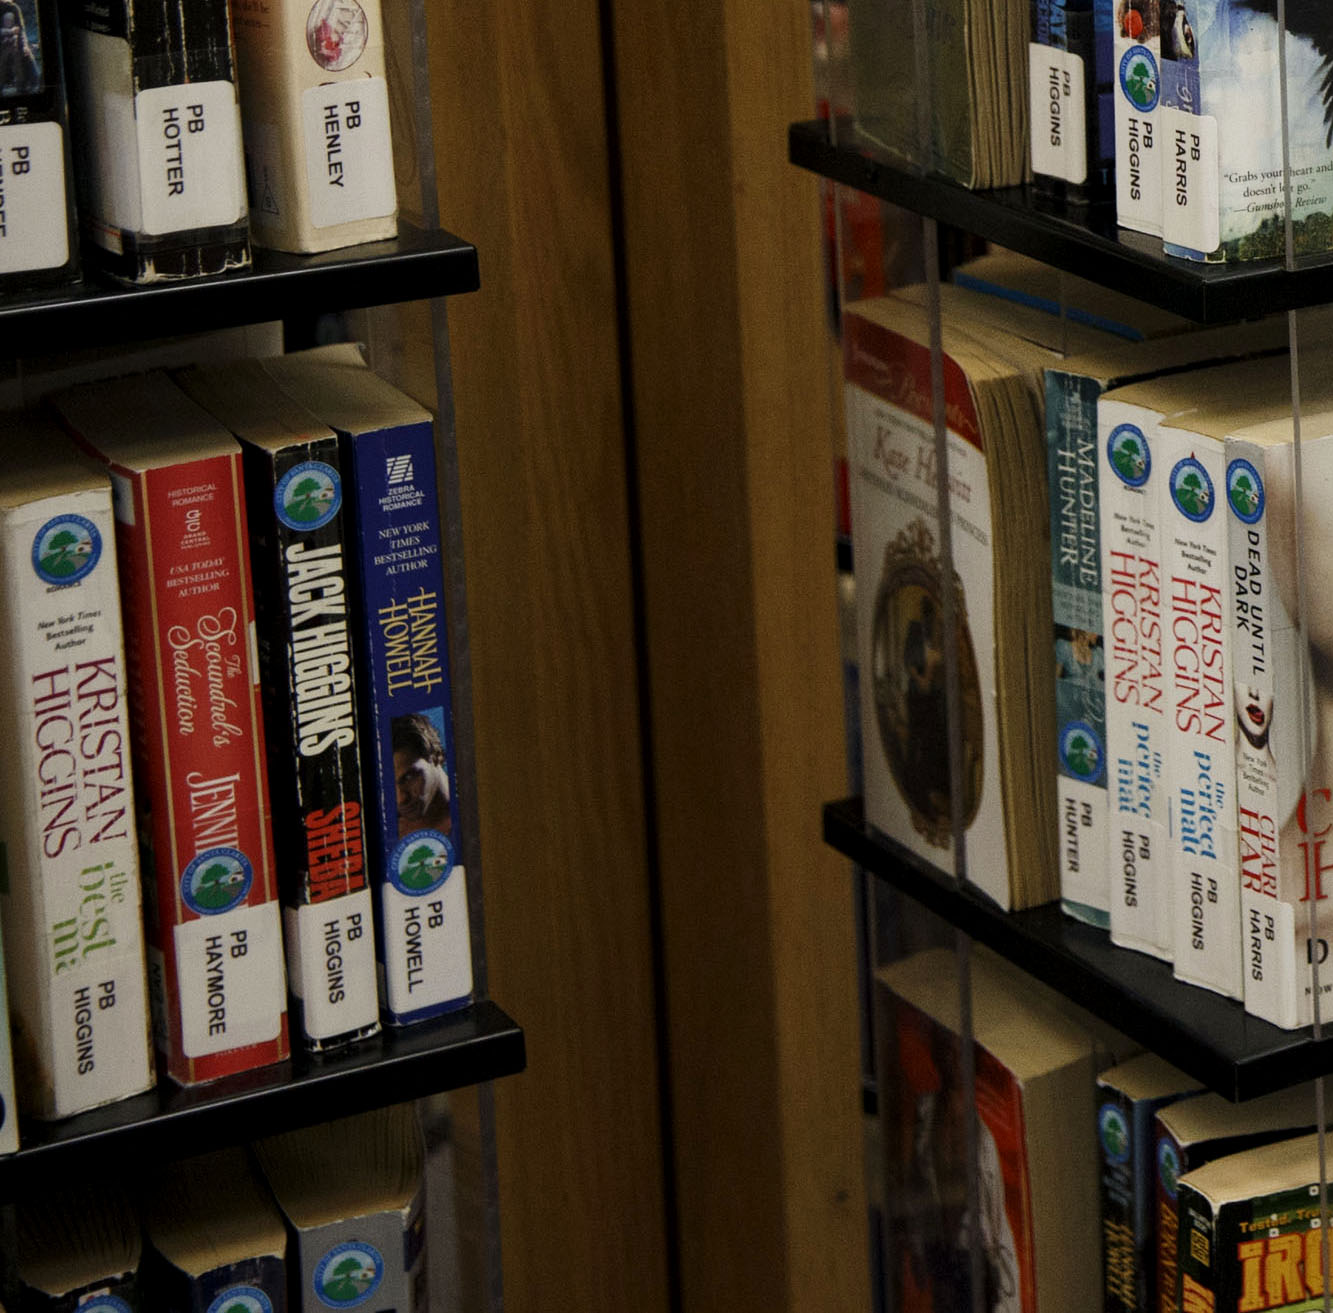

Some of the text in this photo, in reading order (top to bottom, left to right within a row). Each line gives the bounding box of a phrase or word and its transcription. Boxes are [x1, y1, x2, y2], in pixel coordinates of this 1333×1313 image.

[186, 104, 204, 134] PB
[345, 101, 361, 130] PB
[1049, 67, 1061, 147] HIGGINS
[1062, 70, 1071, 96] PB
[11, 146, 30, 176] PB
[163, 107, 184, 197] HOTTER
[323, 104, 344, 189] HENLEY
[1128, 117, 1140, 201] HIGGINS
[1143, 121, 1153, 149] PB
[1175, 129, 1187, 206] HARRIS
[1190, 133, 1200, 161] PB
[1315, 161, 1333, 173] and
[1295, 196, 1327, 208] Review
[378, 490, 425, 505] HISTORICAL
[378, 521, 430, 539] NEW YORK
[1057, 449, 1078, 566] HUNTER
[1077, 437, 1098, 587] MADELINE
[374, 545, 437, 565] BESTSELLING
[386, 560, 428, 575] AUTHOR
[390, 536, 421, 549] TIMES
[1110, 550, 1141, 706] HIGGINS
[1138, 555, 1163, 715] KRISTAN
[1235, 565, 1249, 630] DARK
[1247, 530, 1265, 675] DEAD UNTIL
[286, 542, 355, 757] JACK HIGGINS
[378, 597, 412, 697] HOWELL
[407, 586, 443, 695] HANNAH
[1171, 576, 1201, 735] HIGGINS
[1200, 584, 1226, 744] KRISTAN
[167, 625, 203, 736] Seduction
[32, 666, 82, 859] HIGGINS
[75, 656, 128, 846] KRISTAN
[1065, 798, 1079, 872] HUNTER
[1081, 802, 1091, 827] PB
[1139, 835, 1150, 860] PB
[1122, 830, 1137, 907] HIGGINS
[1208, 877, 1217, 903] PB
[230, 929, 248, 958] PB
[346, 913, 362, 942] PB
[427, 900, 443, 930] PB
[1191, 872, 1204, 950] HIGGINS
[1250, 909, 1263, 982] HARRIS
[1265, 915, 1274, 940] PB
[205, 935, 226, 1036] HAYMORE
[324, 919, 345, 1005] HIGGINS
[405, 906, 423, 994] HOWELL
[75, 986, 94, 1076] HIGGINS
[98, 981, 115, 1010] PB
